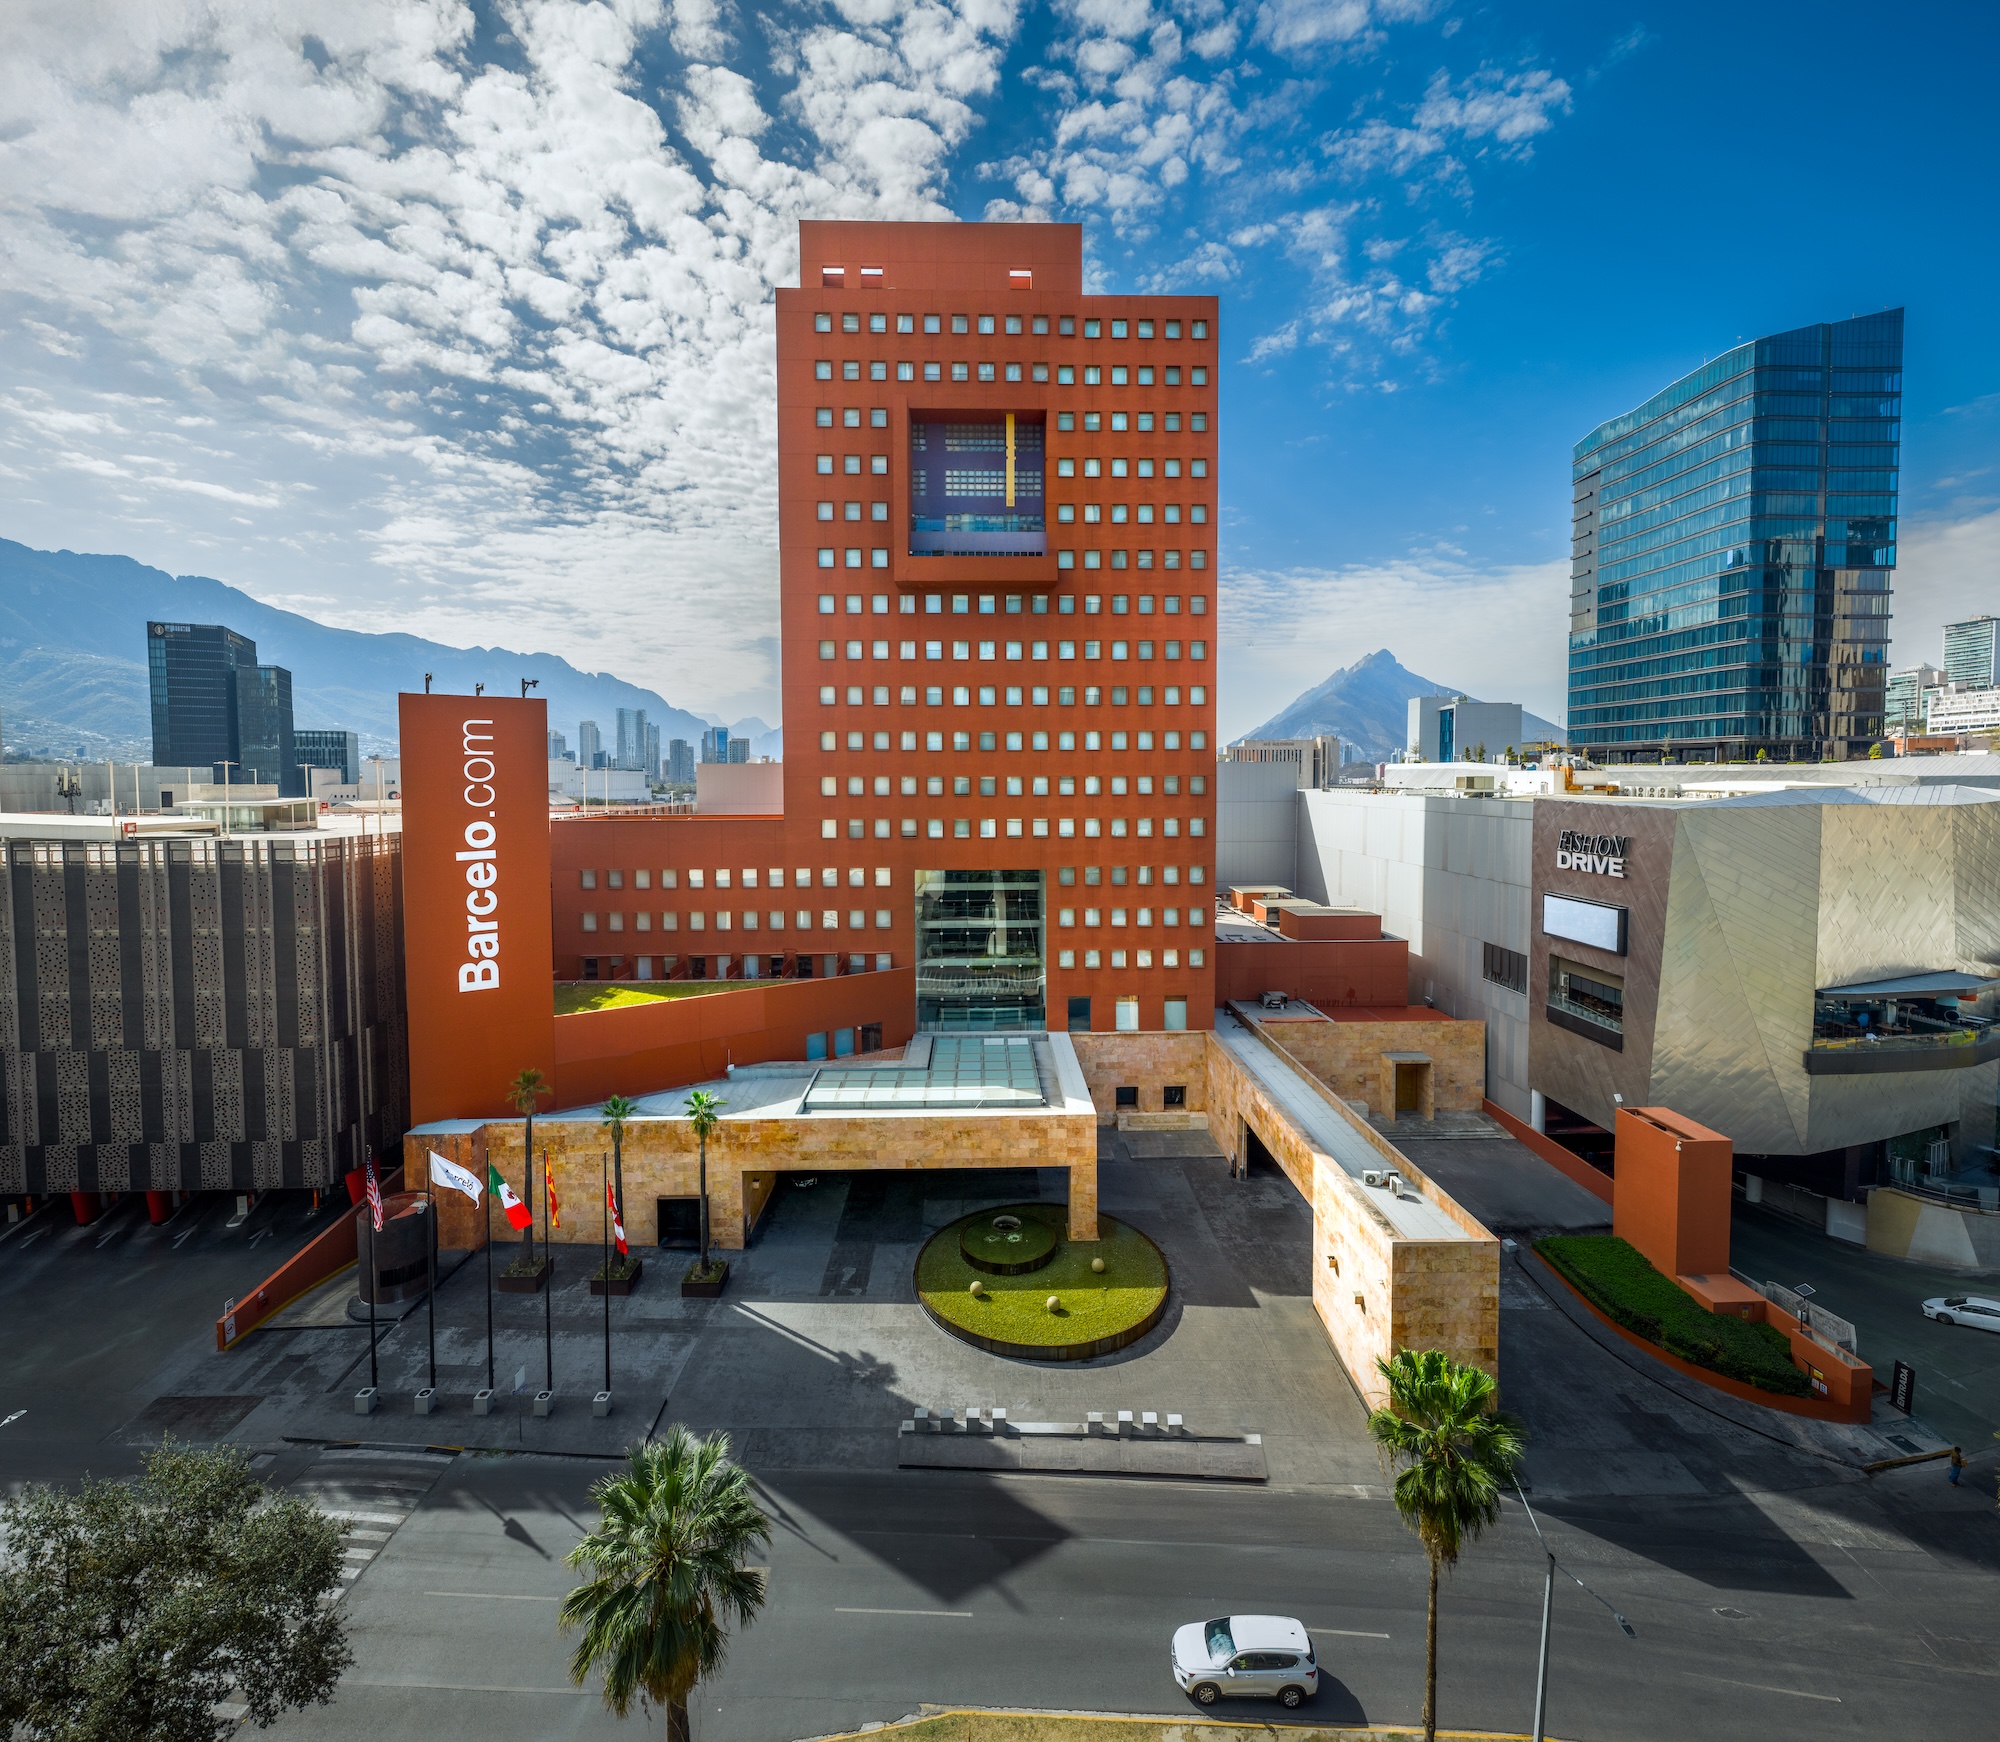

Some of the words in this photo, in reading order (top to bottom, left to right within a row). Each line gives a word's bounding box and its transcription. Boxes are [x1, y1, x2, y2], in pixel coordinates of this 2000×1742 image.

[455, 719, 500, 993] Barcelo.com
[1557, 829, 1627, 857] FASHION
[1556, 850, 1624, 878] DRIVE
[1897, 1367, 1909, 1408] ENTRADA
